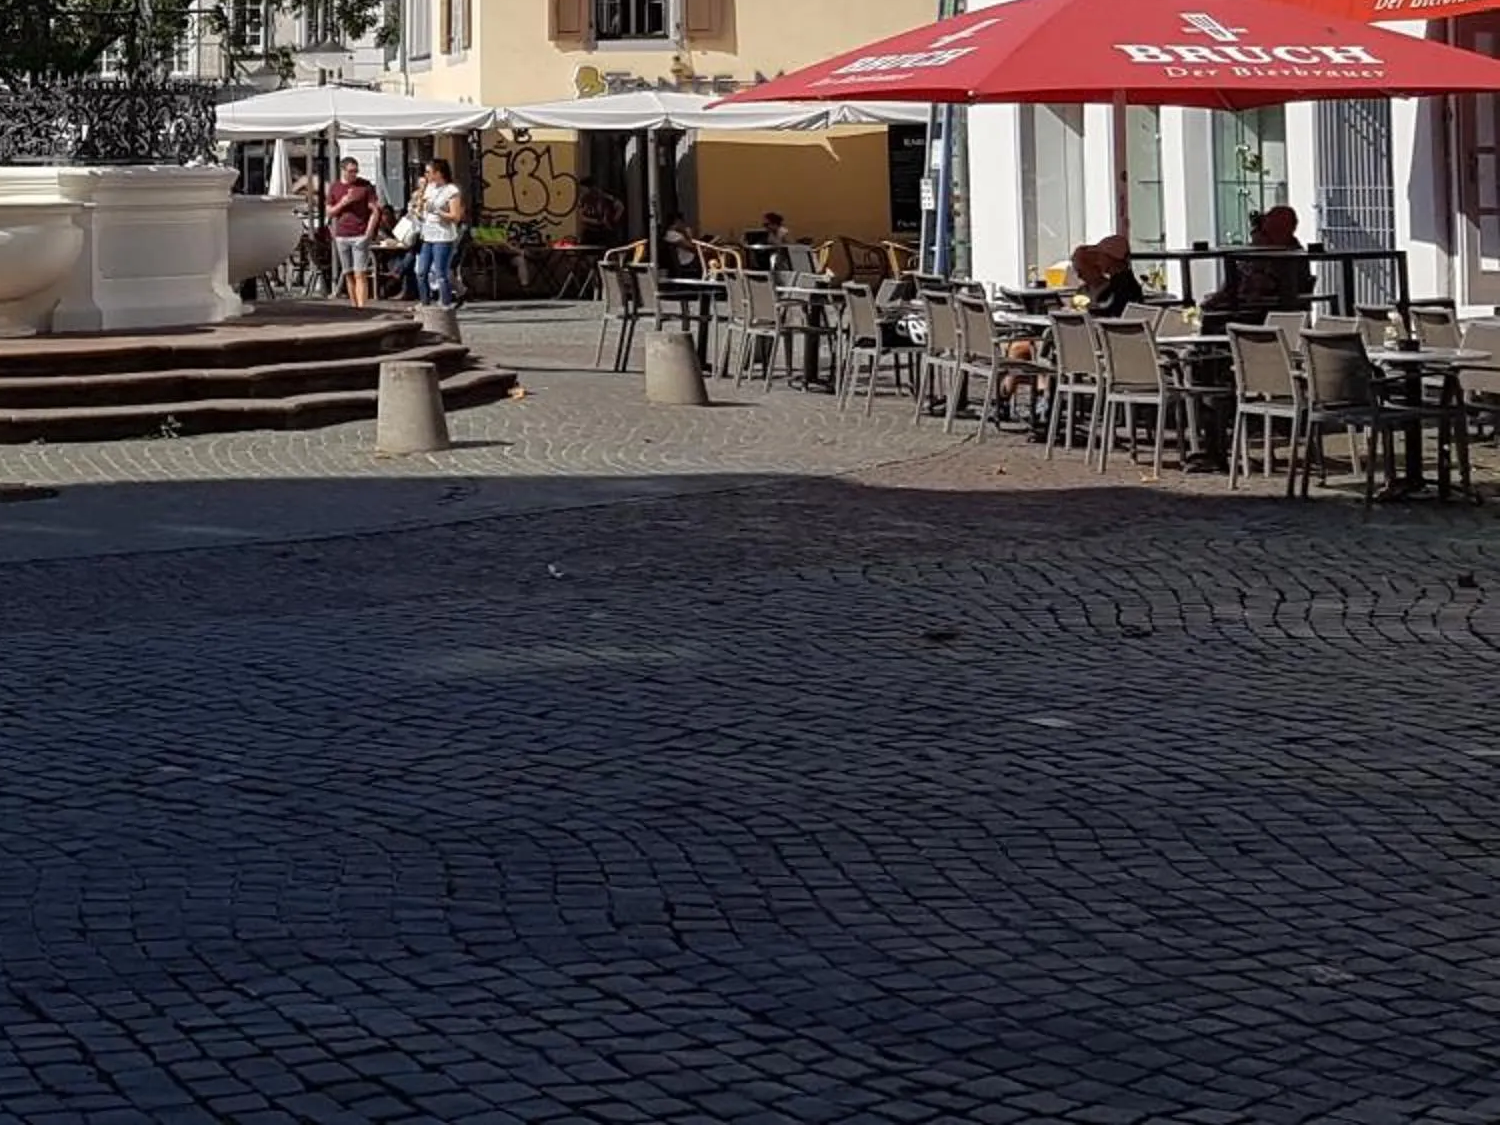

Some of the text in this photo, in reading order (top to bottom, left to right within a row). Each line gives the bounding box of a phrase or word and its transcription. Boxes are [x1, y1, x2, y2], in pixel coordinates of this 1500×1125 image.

[1114, 44, 1384, 64] BRUCH
[1164, 64, 1385, 78] Der Bierbrauer
